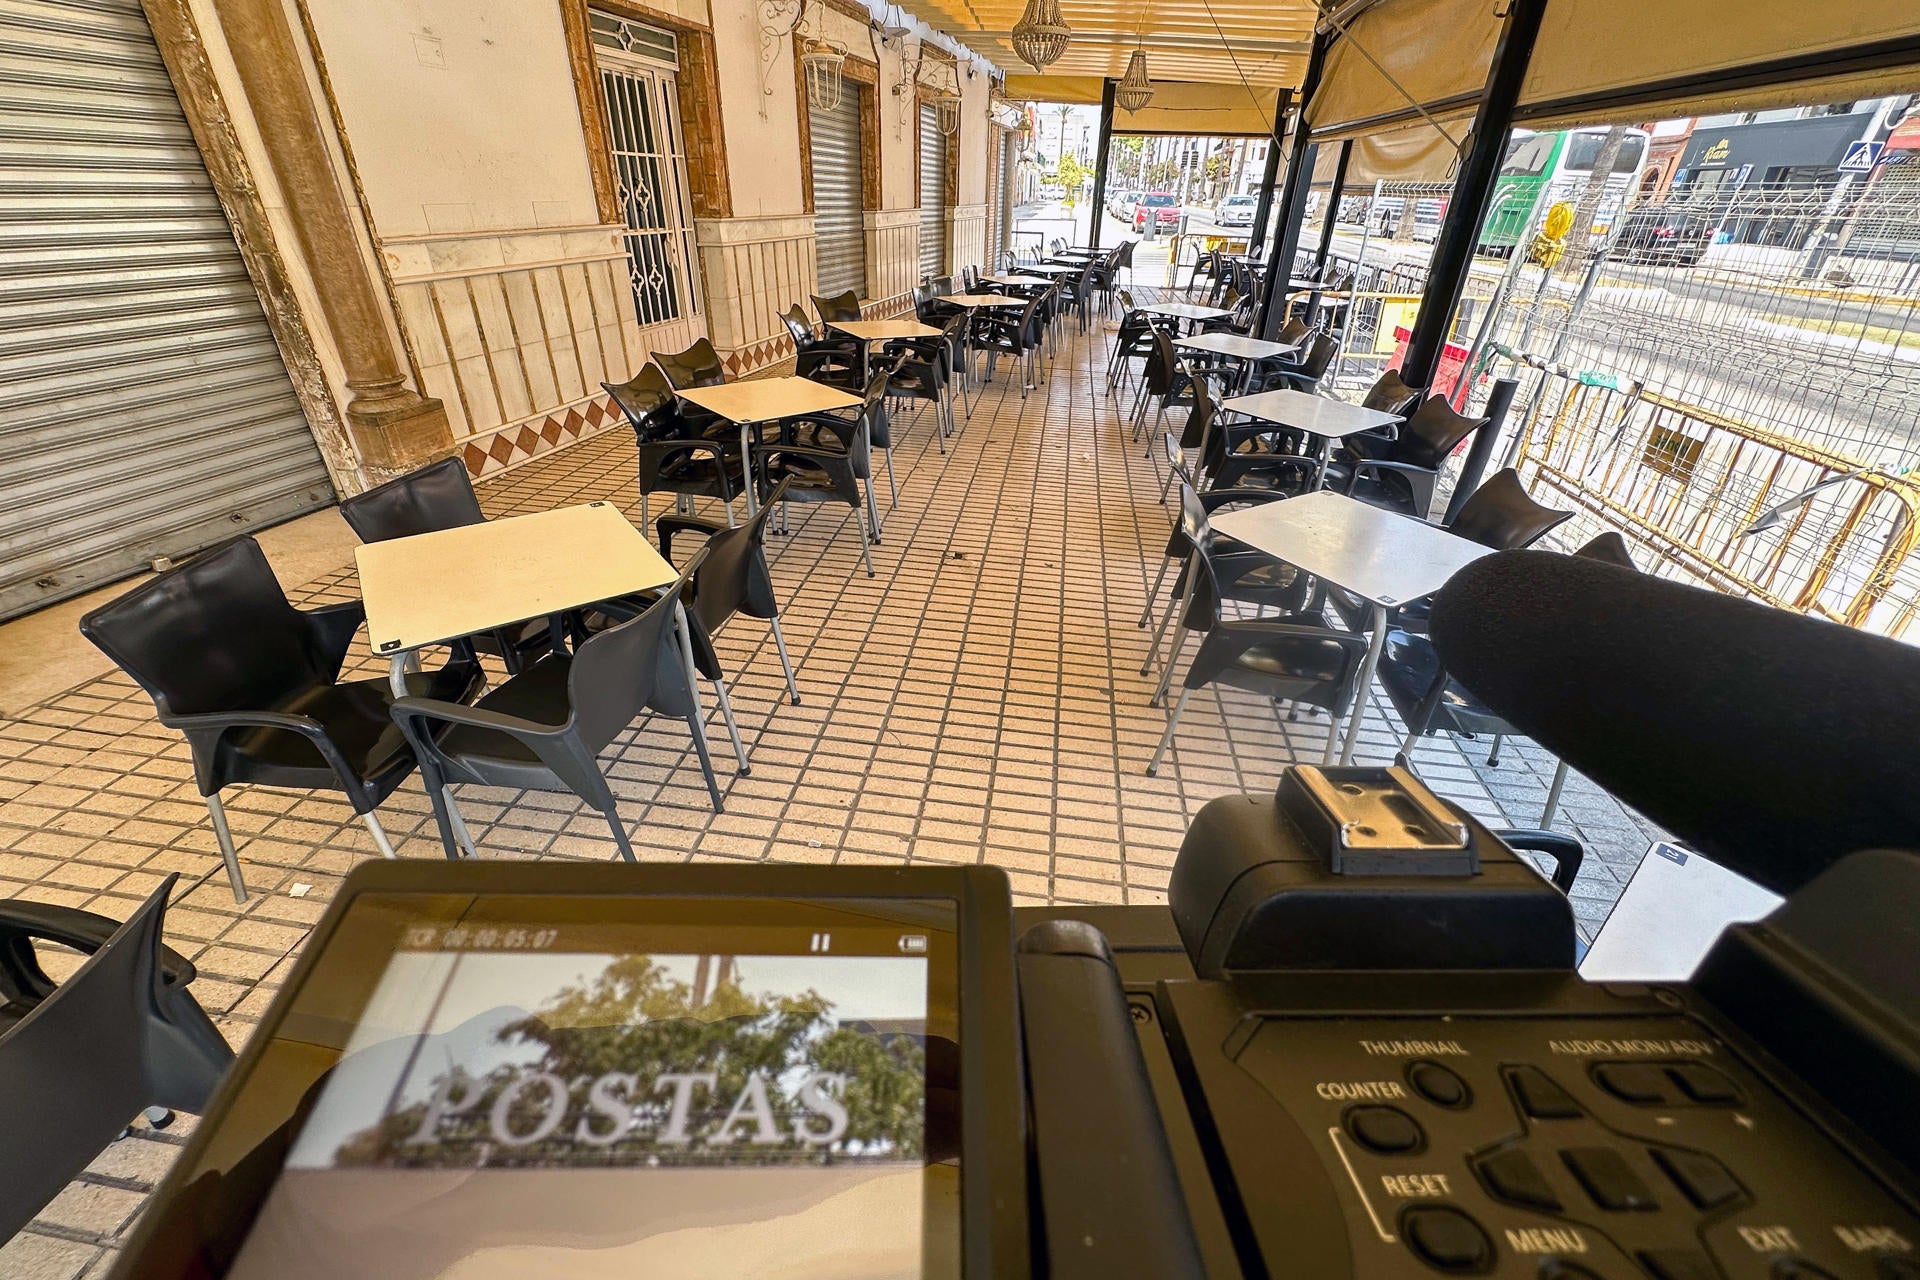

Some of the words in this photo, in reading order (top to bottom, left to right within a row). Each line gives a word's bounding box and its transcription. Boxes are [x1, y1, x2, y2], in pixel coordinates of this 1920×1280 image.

[1359, 1040, 1470, 1056] THUMBNAIL
[1549, 1039, 1613, 1055] AUDIO
[1316, 1081, 1408, 1099] COUNTER
[404, 1070, 850, 1147] POSTAS
[1381, 1174, 1451, 1196] RESET
[1504, 1227, 1588, 1253] MENU
[1736, 1225, 1801, 1252] EXIT
